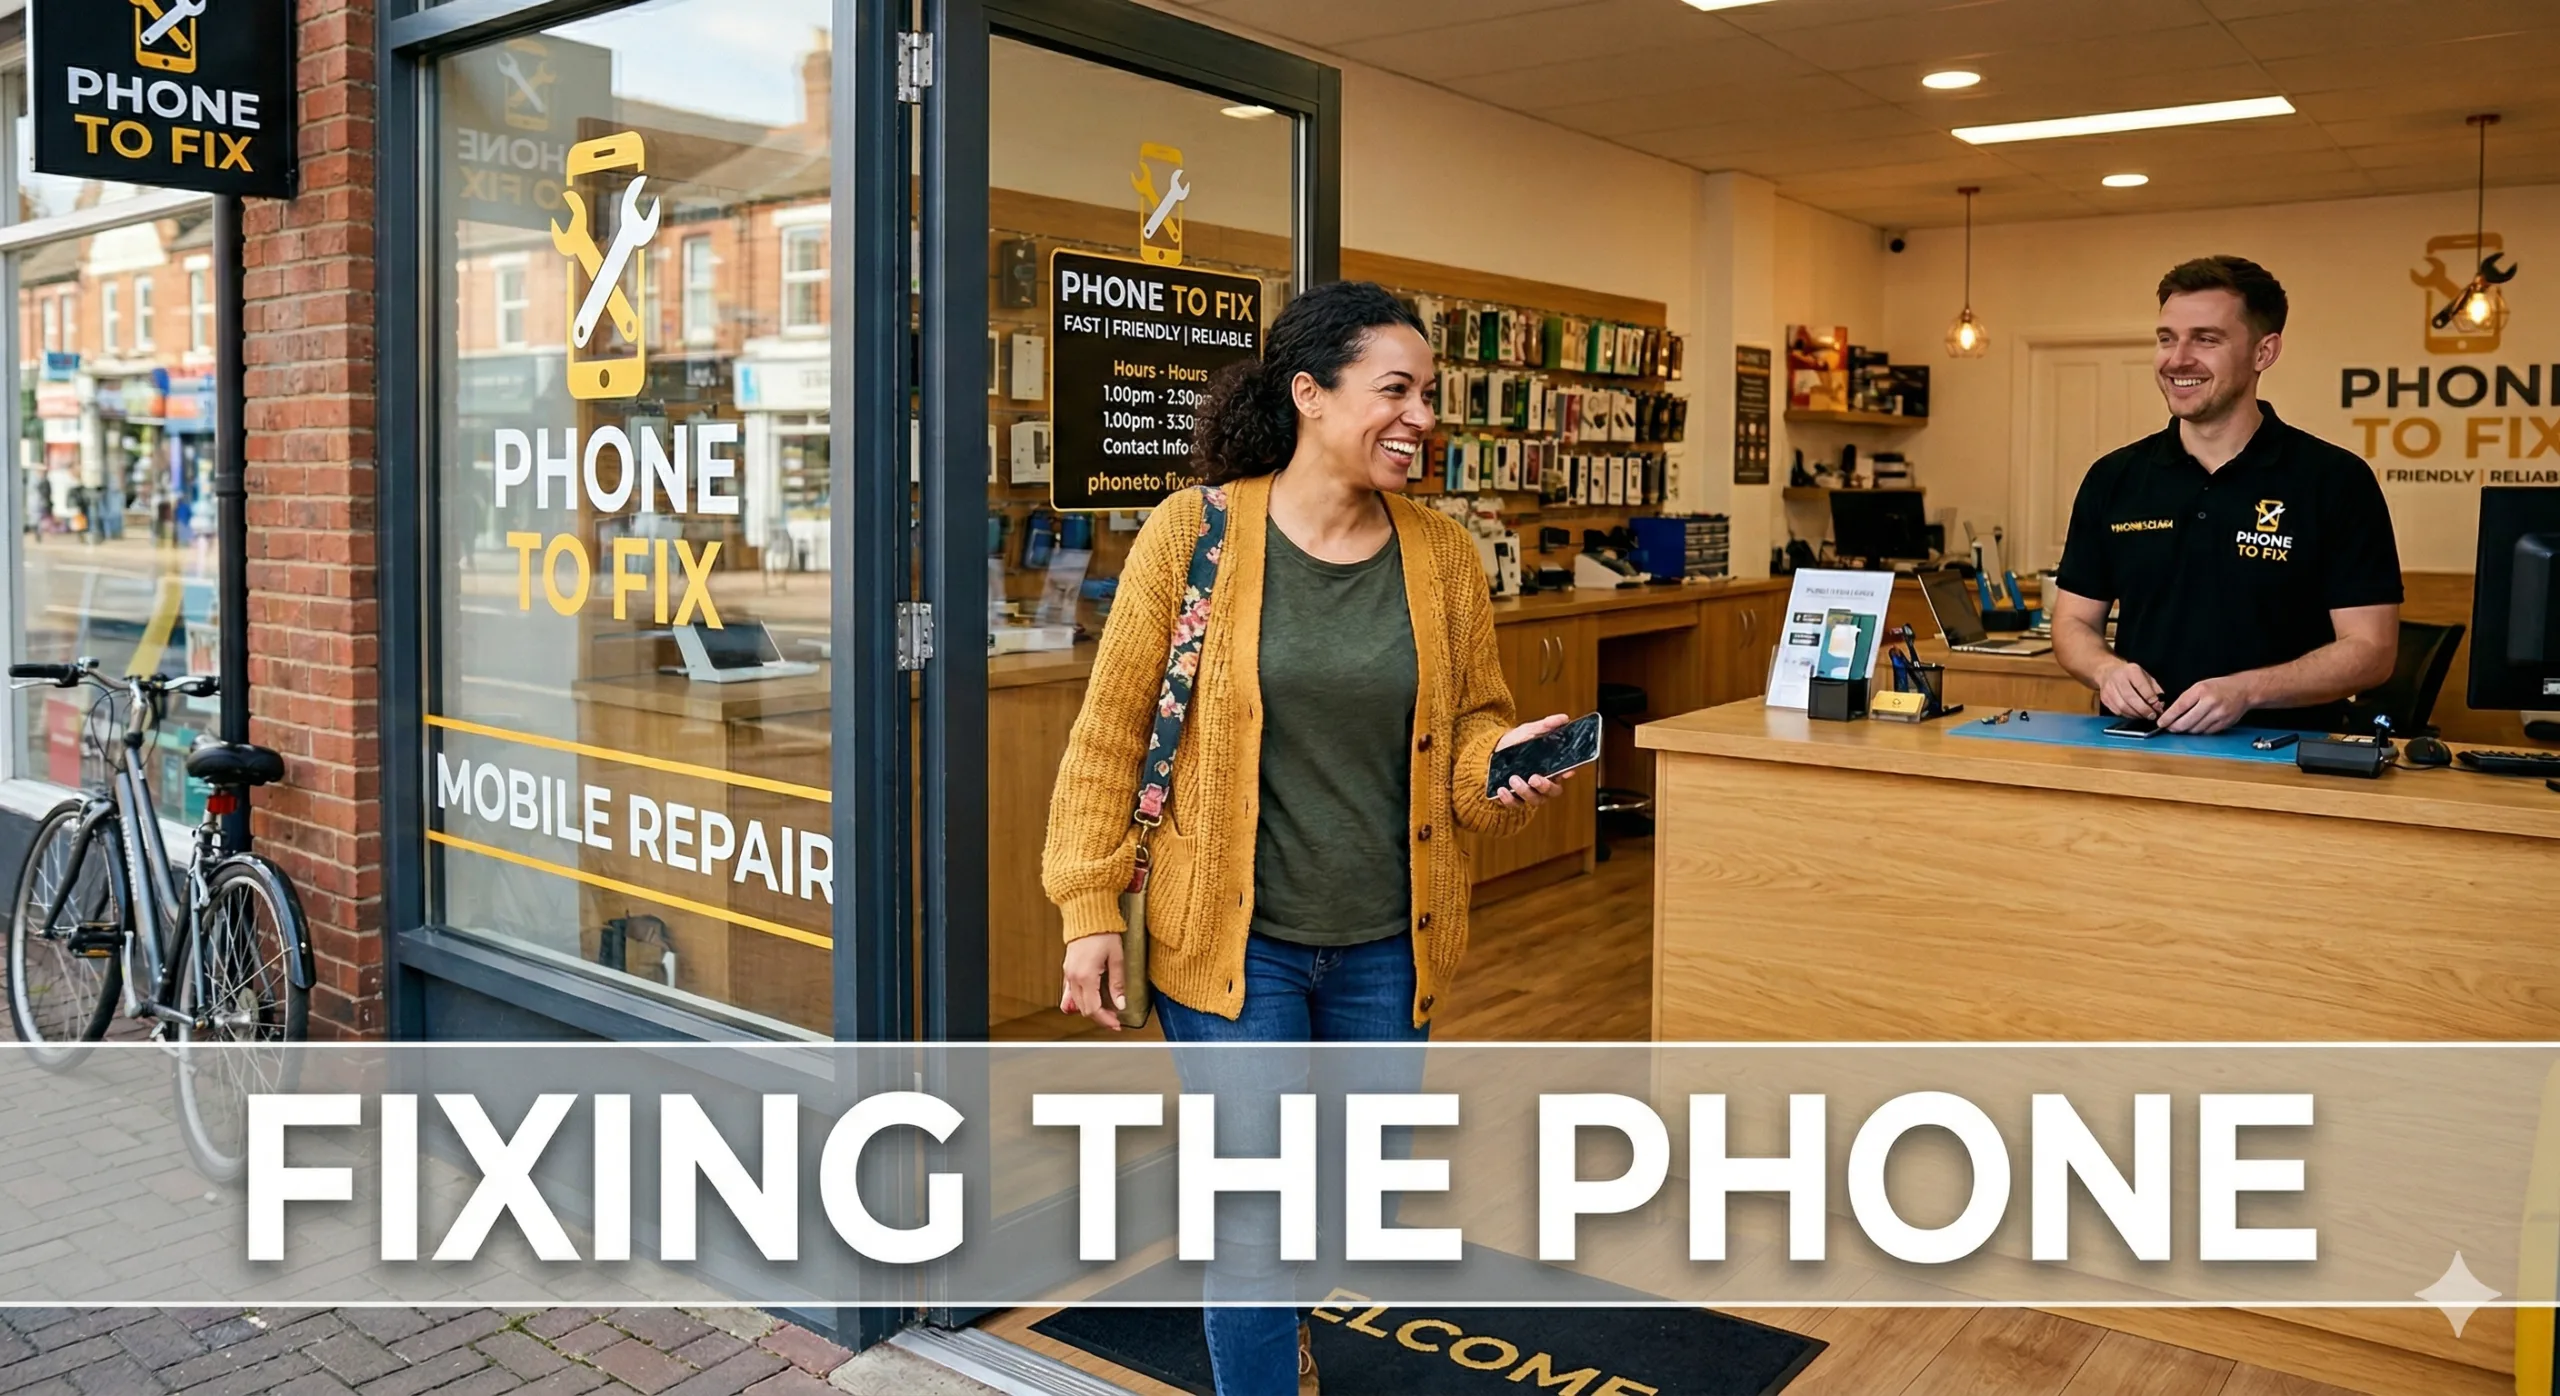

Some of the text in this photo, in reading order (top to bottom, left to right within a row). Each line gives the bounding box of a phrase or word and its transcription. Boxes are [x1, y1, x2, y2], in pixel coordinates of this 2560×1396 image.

[66, 66, 261, 131] PHONE
[74, 113, 255, 173] TO FIX
[1061, 269, 1255, 323] PHONE TO FIX
[1063, 314, 1102, 334] FAST
[1112, 319, 1182, 342] FRIENDLY
[1191, 327, 1253, 349] RELIABLE
[1113, 359, 1157, 379] Hours
[1167, 363, 1209, 382] Hours
[2340, 364, 2560, 409] PHON
[1103, 384, 1155, 407] 1.00pm
[1103, 411, 1155, 433] 1.00pm
[2352, 415, 2560, 460] TO FIX
[1103, 437, 1160, 455] Contact
[493, 422, 740, 515] PHONE
[2386, 468, 2476, 484] FRIENDLY
[2235, 530, 2294, 549] PHONE
[2237, 543, 2289, 562] TO FIX
[506, 531, 725, 630] TO FIX
[436, 751, 834, 905] MOBILE REPAIR
